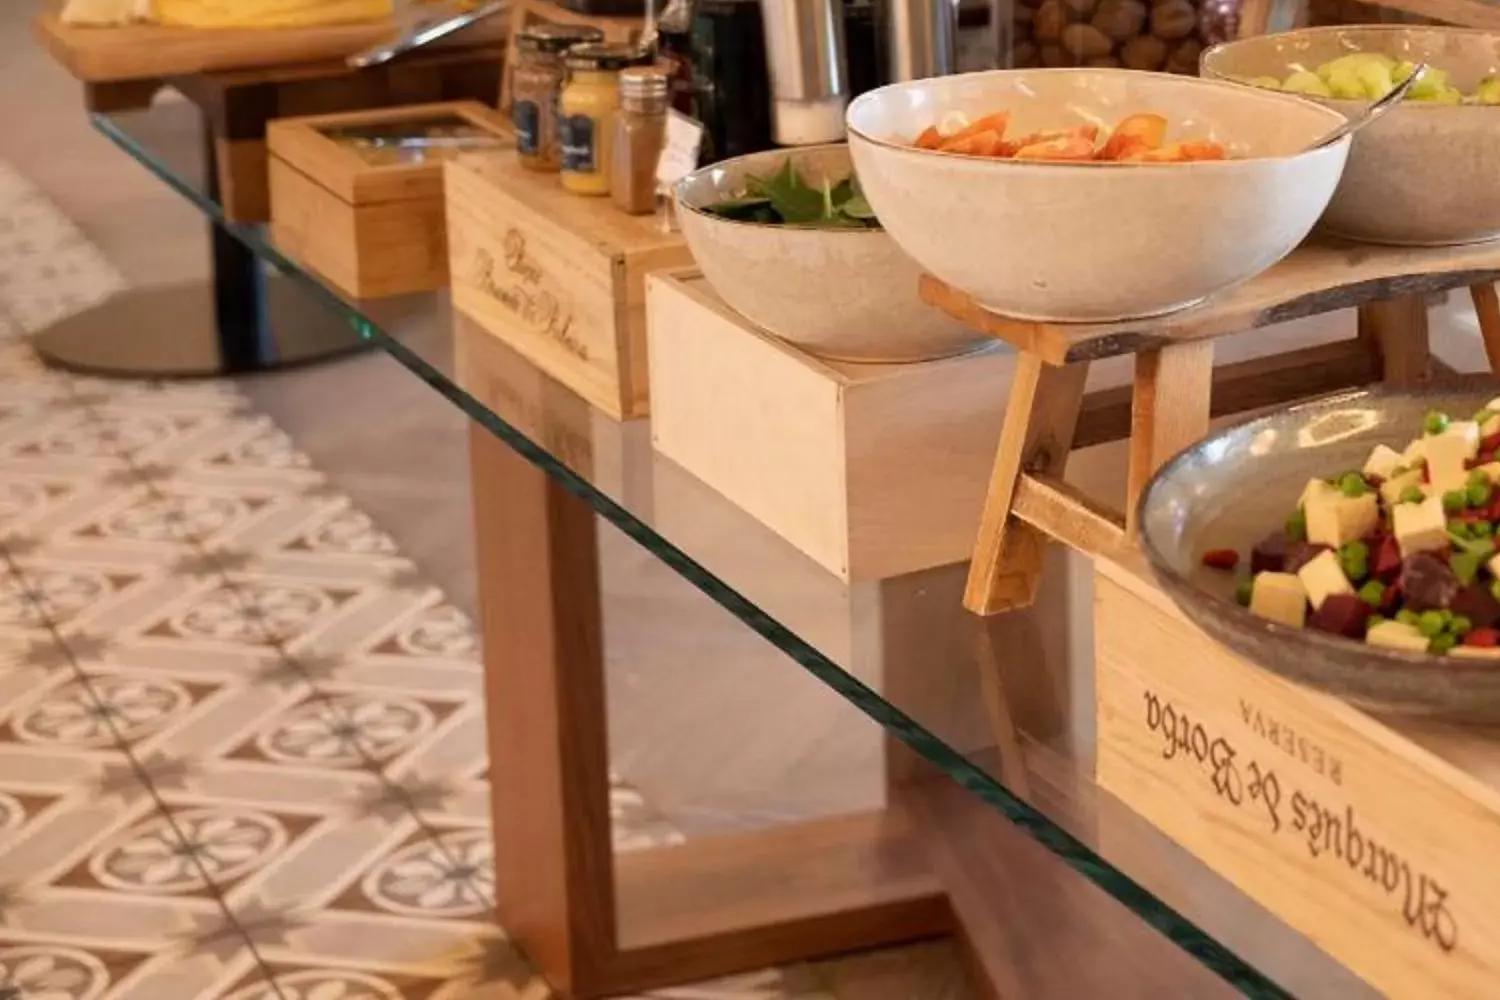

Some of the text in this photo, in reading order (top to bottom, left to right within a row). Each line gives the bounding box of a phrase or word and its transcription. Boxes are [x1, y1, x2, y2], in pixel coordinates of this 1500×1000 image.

[1143, 689, 1458, 954] Marquês de Borba
[1238, 697, 1344, 787] RESERVA
